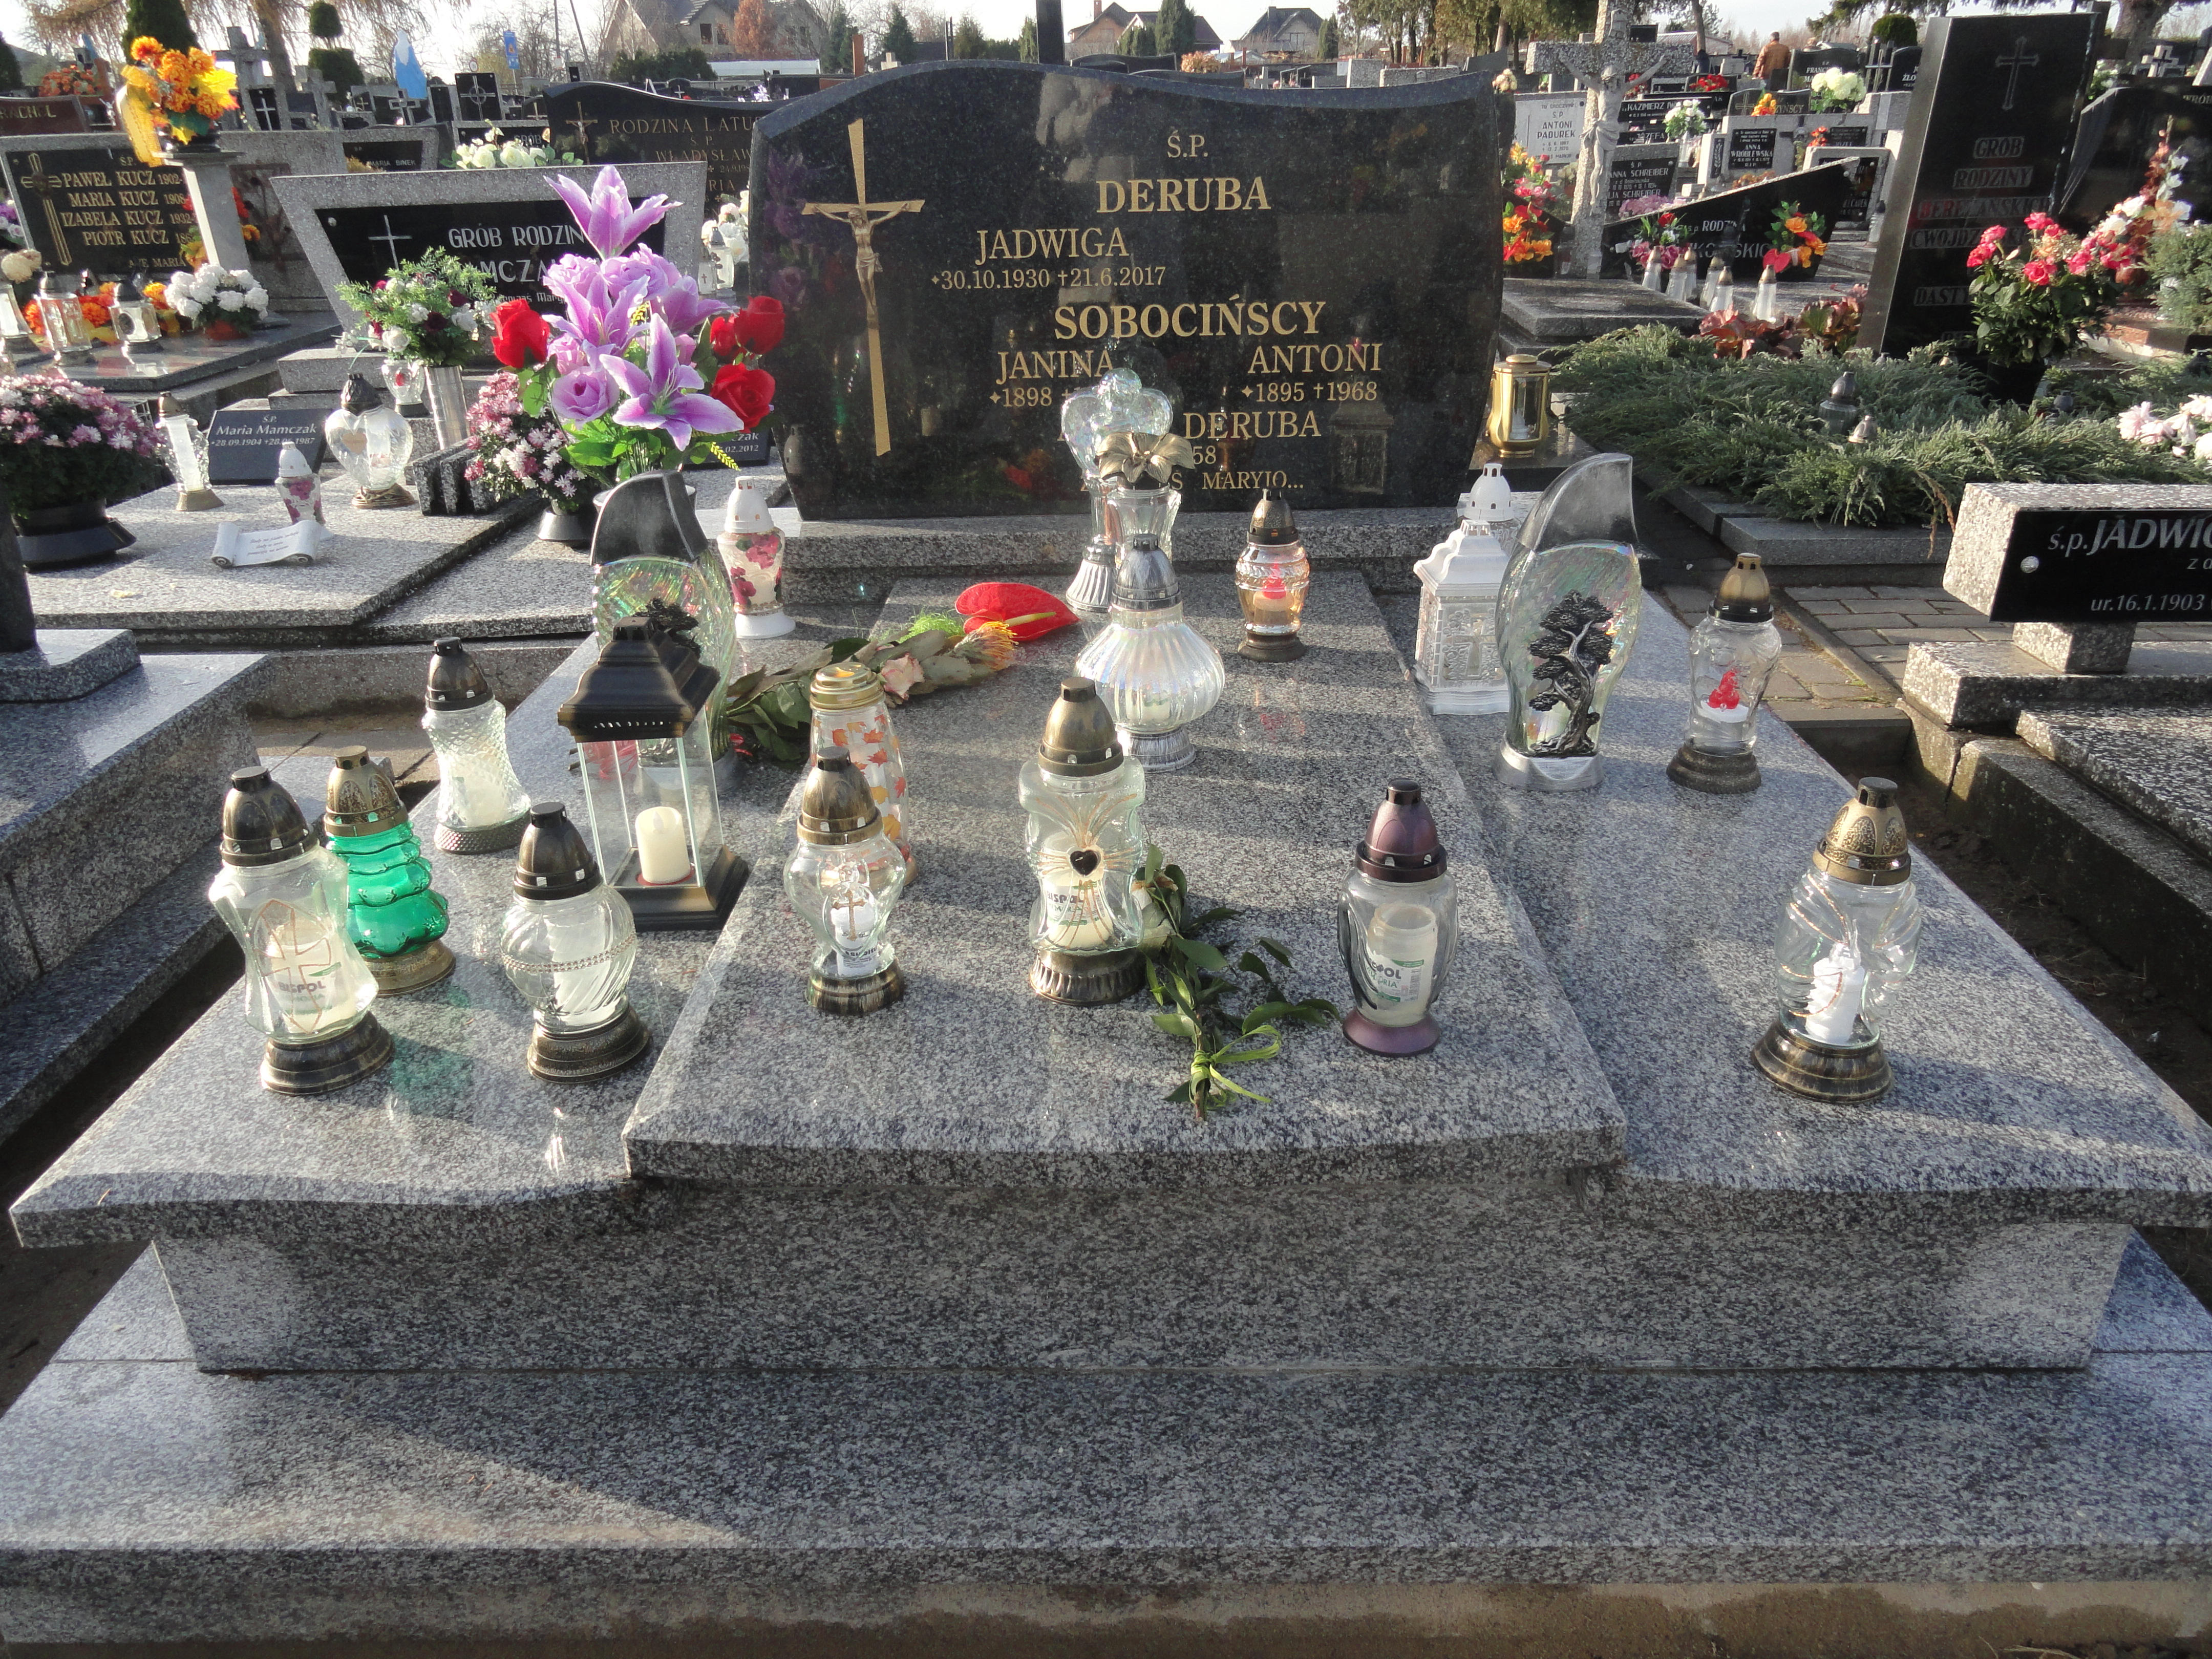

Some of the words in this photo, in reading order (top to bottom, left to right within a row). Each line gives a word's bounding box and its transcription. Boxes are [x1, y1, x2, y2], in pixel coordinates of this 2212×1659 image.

[609, 118, 694, 134] RODZINA
[1542, 120, 1572, 130] ANTONI
[1166, 129, 1209, 158] Ś.P.
[1537, 130, 1576, 139] PADUREK
[62, 172, 112, 187] PAWEŁ
[115, 171, 156, 186] KUCZ
[1630, 167, 1669, 177] SCHREIBER
[68, 192, 116, 207] MARIA
[119, 190, 159, 206] KUCZ
[1095, 176, 1272, 214] DERUBA
[60, 211, 121, 227] IZABELA
[124, 210, 164, 225] KUCZ
[82, 230, 126, 246] PIOTR
[130, 230, 169, 245] KUCZ
[449, 223, 502, 248] GRÓB
[974, 227, 1130, 266] JADWIGA
[154, 257, 186, 268] MARIA
[941, 269, 1050, 290] 30.10.1930
[1070, 266, 1166, 287] 21.6.2017
[1054, 293, 1327, 340] SOBOCIŃSCY
[996, 350, 1114, 385] JANINA
[1247, 343, 1382, 374] ANTONI
[1002, 386, 1052, 408] 1898
[1256, 382, 1305, 402] 1895
[1327, 381, 1377, 401] 1968
[216, 424, 252, 435] Maria
[257, 423, 316, 435] Mamczak
[1183, 410, 1322, 439] DERUBA
[2090, 593, 2205, 612] ur.16.1.1903
